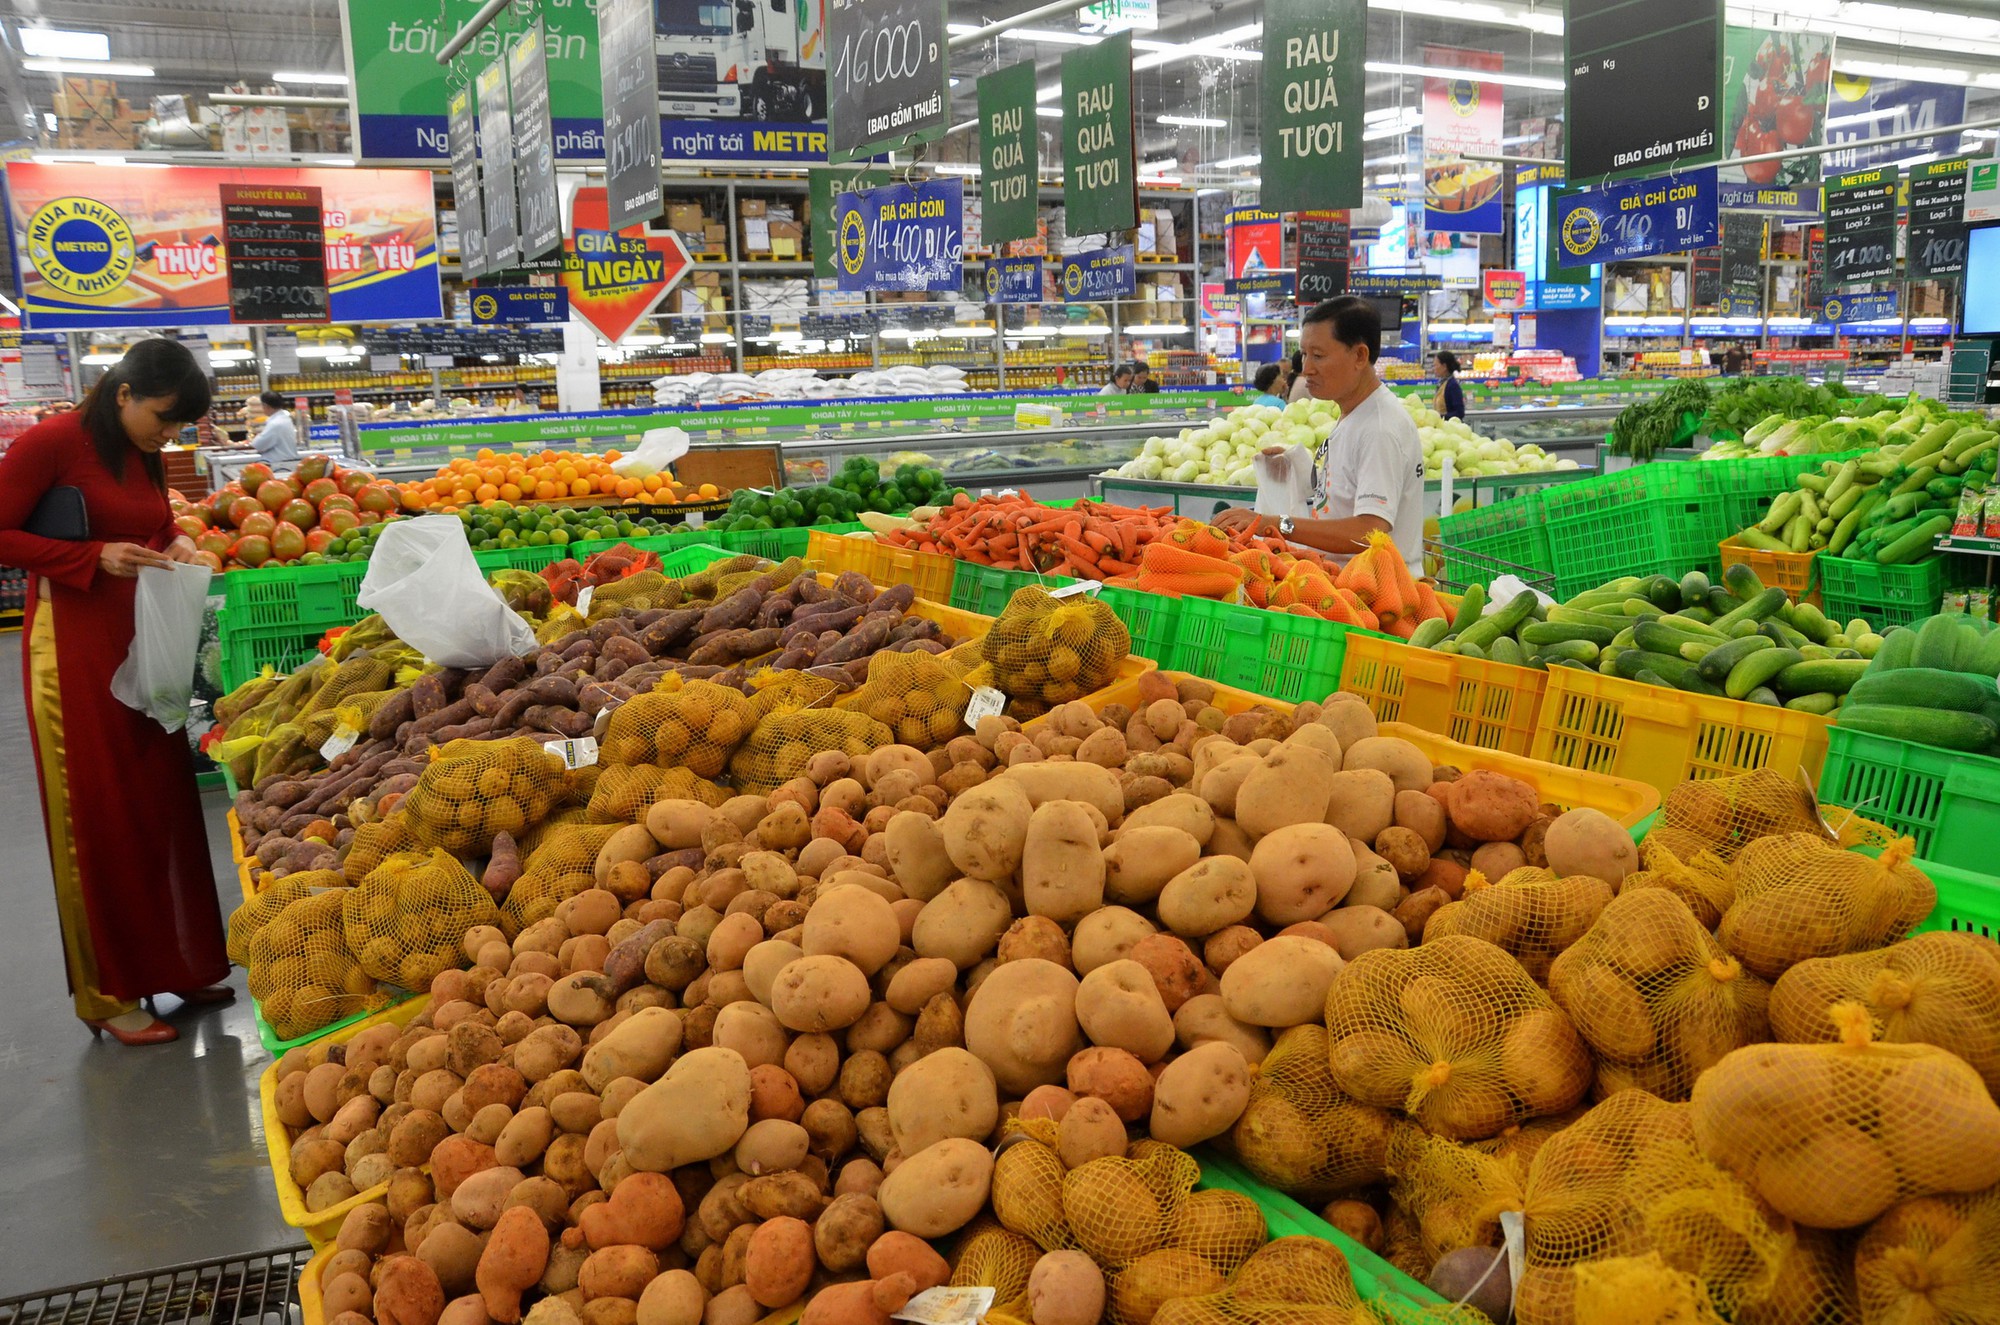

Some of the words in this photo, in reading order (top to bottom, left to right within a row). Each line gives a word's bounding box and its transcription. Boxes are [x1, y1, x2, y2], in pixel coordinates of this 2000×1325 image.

[388, 17, 437, 53] tới
[834, 19, 922, 94] 16.000
[929, 42, 938, 63] Đ
[1286, 29, 1339, 69] RAU
[1603, 59, 1616, 69] Kg
[1078, 83, 1114, 118] RAU
[1284, 65, 1339, 114] QUẢ
[1697, 96, 1710, 110] Đ
[867, 115, 889, 136] (BAO
[891, 102, 913, 128] GỒM
[914, 90, 941, 119] THUẾ)
[992, 107, 1022, 137] RAU
[673, 132, 714, 155] nghĩ
[719, 133, 743, 151] tới
[753, 131, 827, 152] METR
[1078, 112, 1115, 154] QUẢ
[1279, 121, 1342, 158] TƯƠI
[993, 134, 1024, 170] QUẢ
[1614, 150, 1641, 167] (BAO
[1645, 141, 1673, 159] GỒM
[1676, 129, 1713, 152] THUẾ)
[1075, 158, 1119, 190] TƯƠI
[1841, 171, 1881, 186] METRO
[991, 174, 1026, 204] TƯƠI
[1620, 193, 1642, 211] GIÁ
[1645, 187, 1666, 206] CHỈ
[1669, 184, 1697, 202] CÒN
[1757, 190, 1798, 206] METRO
[1853, 189, 1869, 199] Việt
[1869, 188, 1884, 196] Nam
[881, 200, 897, 222] GIÁ
[899, 196, 918, 219] CHỈ
[919, 195, 945, 218] CÒN
[1864, 216, 1871, 226] 2
[33, 206, 67, 242] MUA
[1565, 213, 1577, 232] MUA
[55, 241, 109, 253] METRO
[373, 235, 414, 269] YẾU
[577, 232, 617, 253] GIÁ
[1614, 245, 1627, 256] Khi
[1628, 245, 1644, 254] mua
[154, 242, 217, 279] THỰC
[588, 255, 662, 287] NGÀY
[1236, 281, 1251, 290] Food
[1252, 279, 1281, 290] Solutions
[681, 417, 707, 426] KHOAI
[708, 416, 723, 425] TÂY
[811, 411, 836, 419] KHOAI
[837, 409, 852, 418] TÂY
[934, 405, 956, 413] KHOAI
[957, 403, 971, 412] TÂY
[390, 434, 419, 443] KHOAI
[422, 432, 439, 441] TÂY
[540, 425, 568, 435] KHOAI
[569, 424, 587, 434] TÂY
[567, 742, 575, 766] METRO
